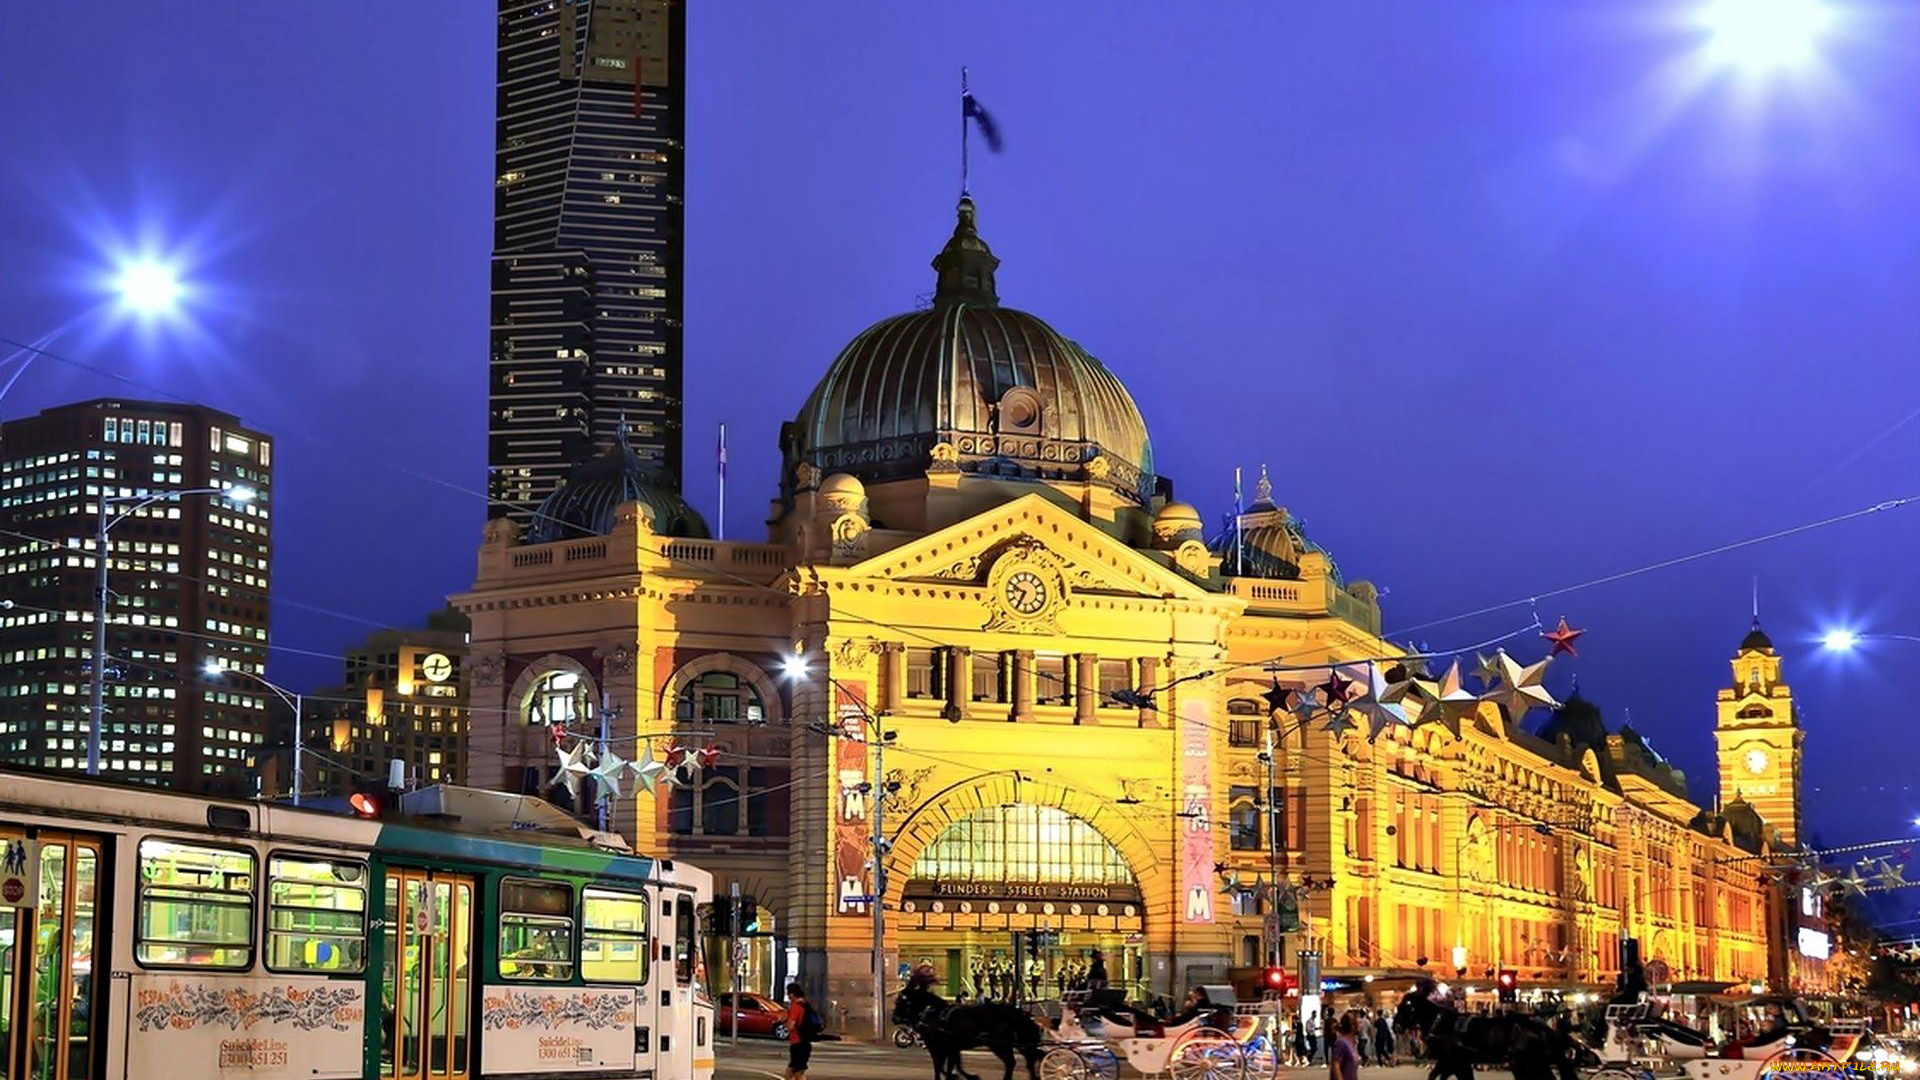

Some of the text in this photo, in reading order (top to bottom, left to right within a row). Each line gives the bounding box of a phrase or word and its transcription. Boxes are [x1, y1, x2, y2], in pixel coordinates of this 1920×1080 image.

[940, 884, 1110, 898] FLINDERS STREET STATION
[221, 1039, 288, 1051] SuicideLine
[271, 1052, 288, 1065] 251
